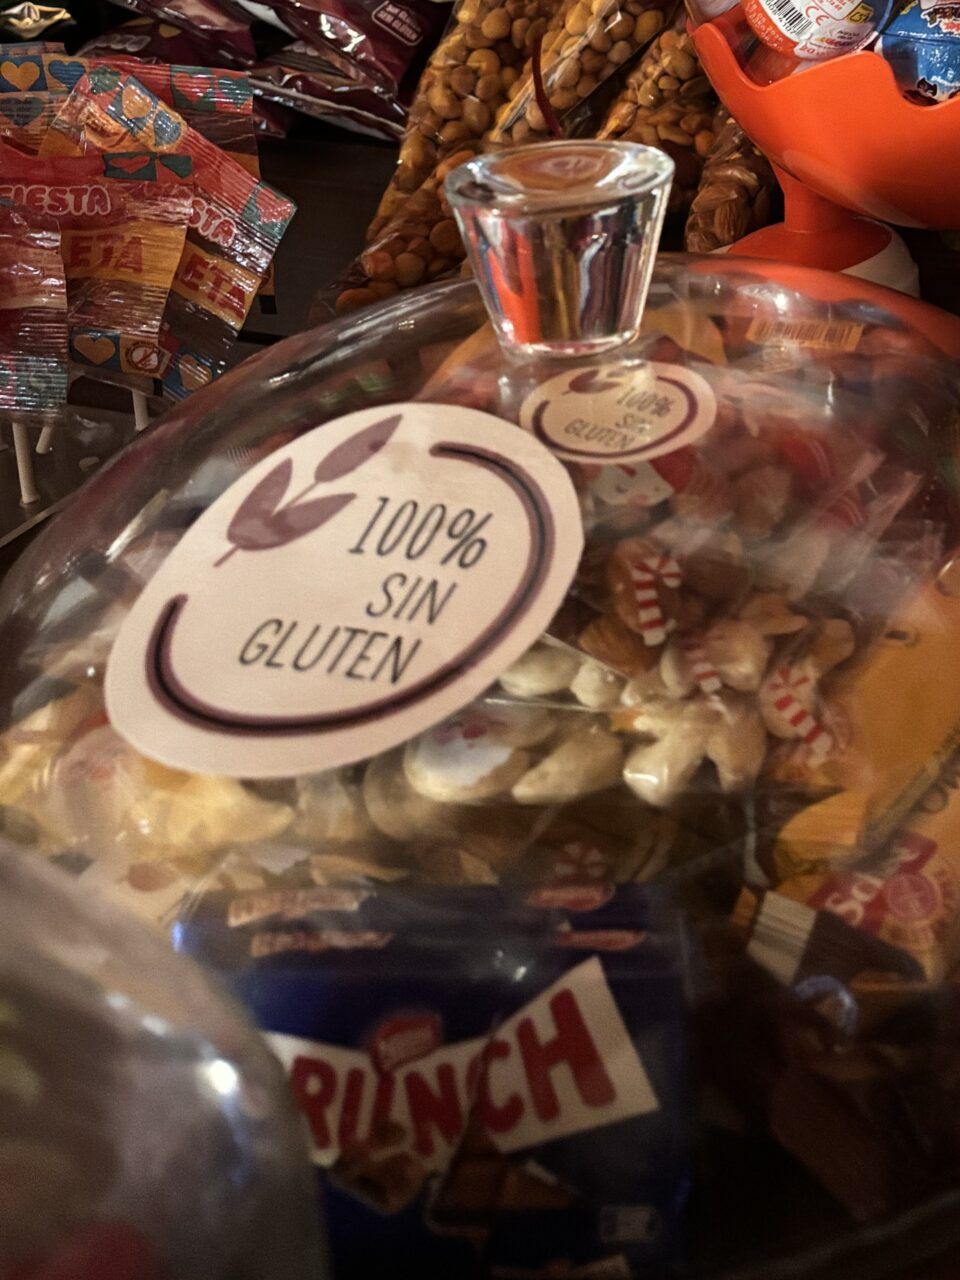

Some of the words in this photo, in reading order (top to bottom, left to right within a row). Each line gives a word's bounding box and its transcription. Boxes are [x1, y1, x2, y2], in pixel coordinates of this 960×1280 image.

[564, 418, 635, 450] GLUTEN
[348, 496, 495, 569] 100%
[367, 572, 457, 625] SIN
[239, 618, 423, 684] GLUTEN
[288, 986, 617, 1158] RUNCH
